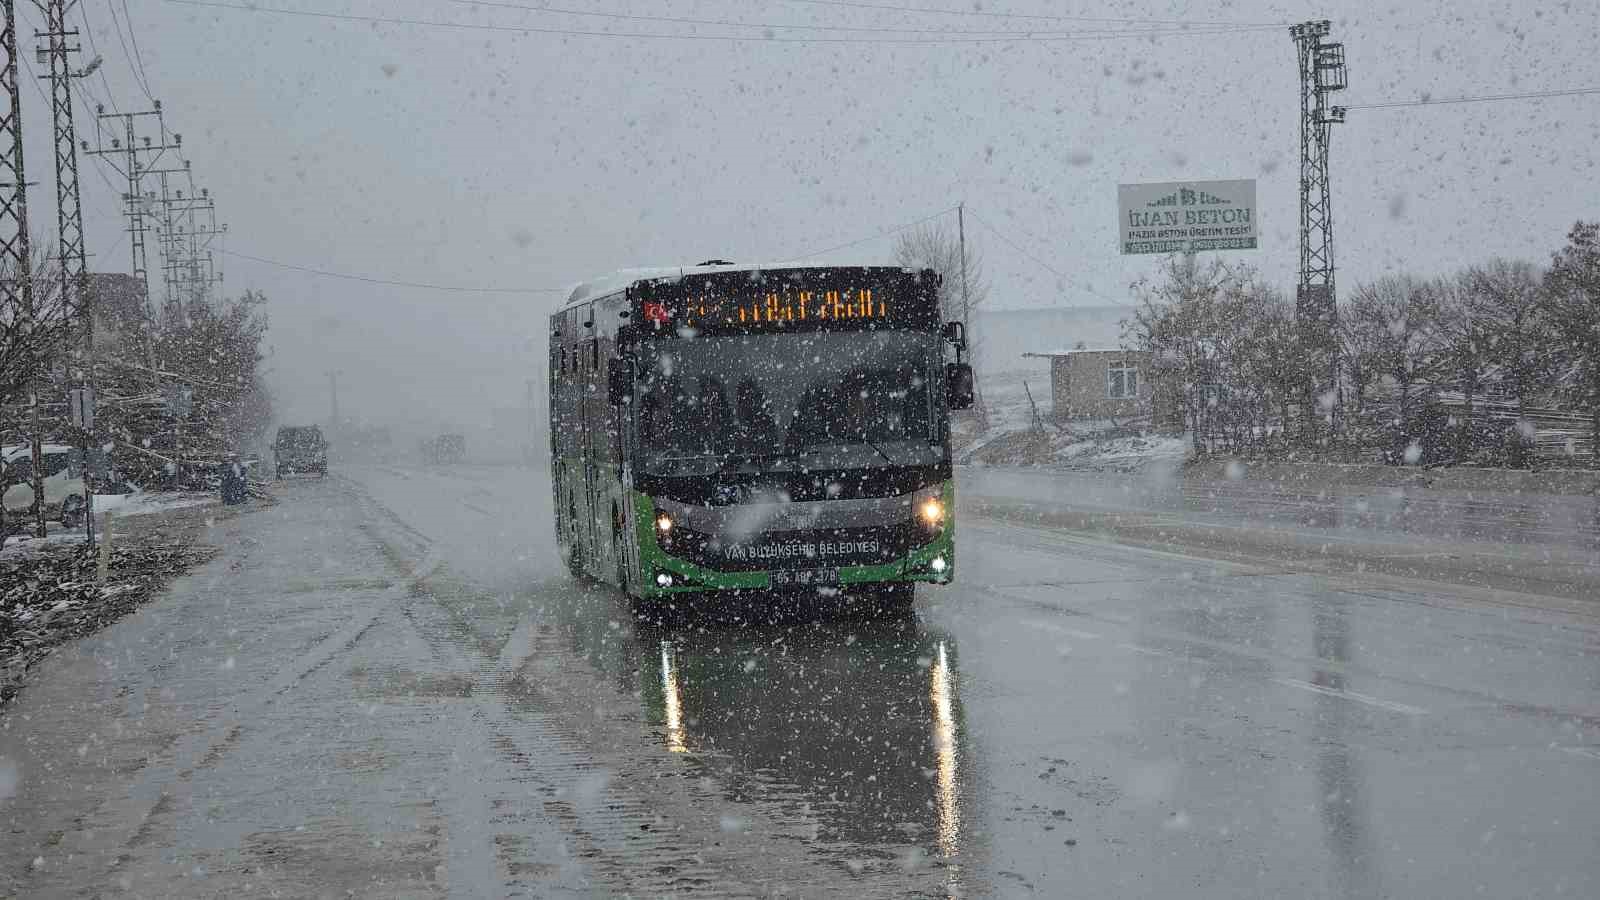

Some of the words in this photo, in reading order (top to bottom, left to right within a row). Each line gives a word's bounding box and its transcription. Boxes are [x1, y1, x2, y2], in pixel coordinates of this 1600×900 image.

[1185, 207, 1251, 226] BETON
[1158, 227, 1188, 239] BETON
[724, 547, 746, 561] VAN
[820, 540, 879, 556] BELEDİYESİ
